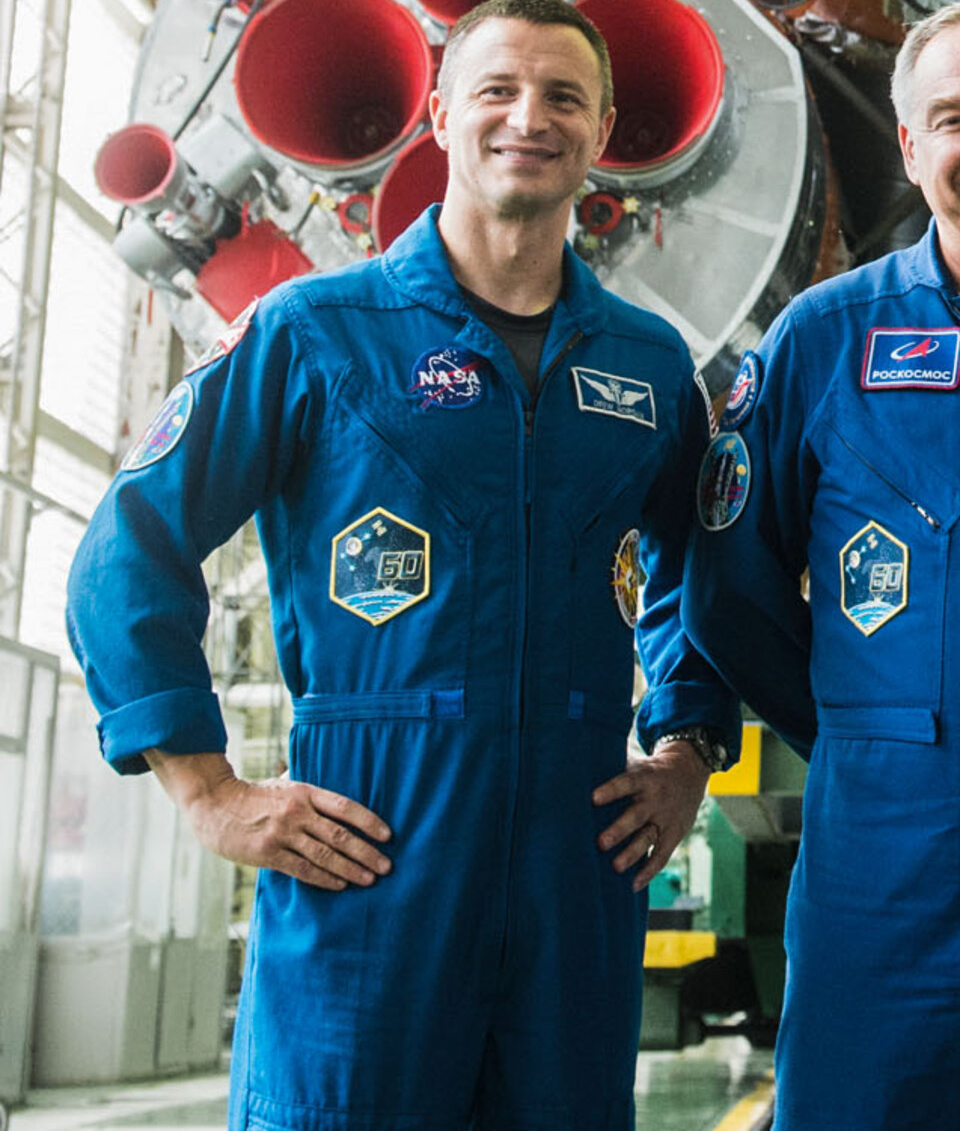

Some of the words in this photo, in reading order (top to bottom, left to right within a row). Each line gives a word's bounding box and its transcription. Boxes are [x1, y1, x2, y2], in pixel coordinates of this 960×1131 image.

[418, 370, 481, 386] NASA
[872, 369, 951, 380] РОСКОСМОС
[378, 551, 424, 580] 60
[869, 562, 904, 592] 60
